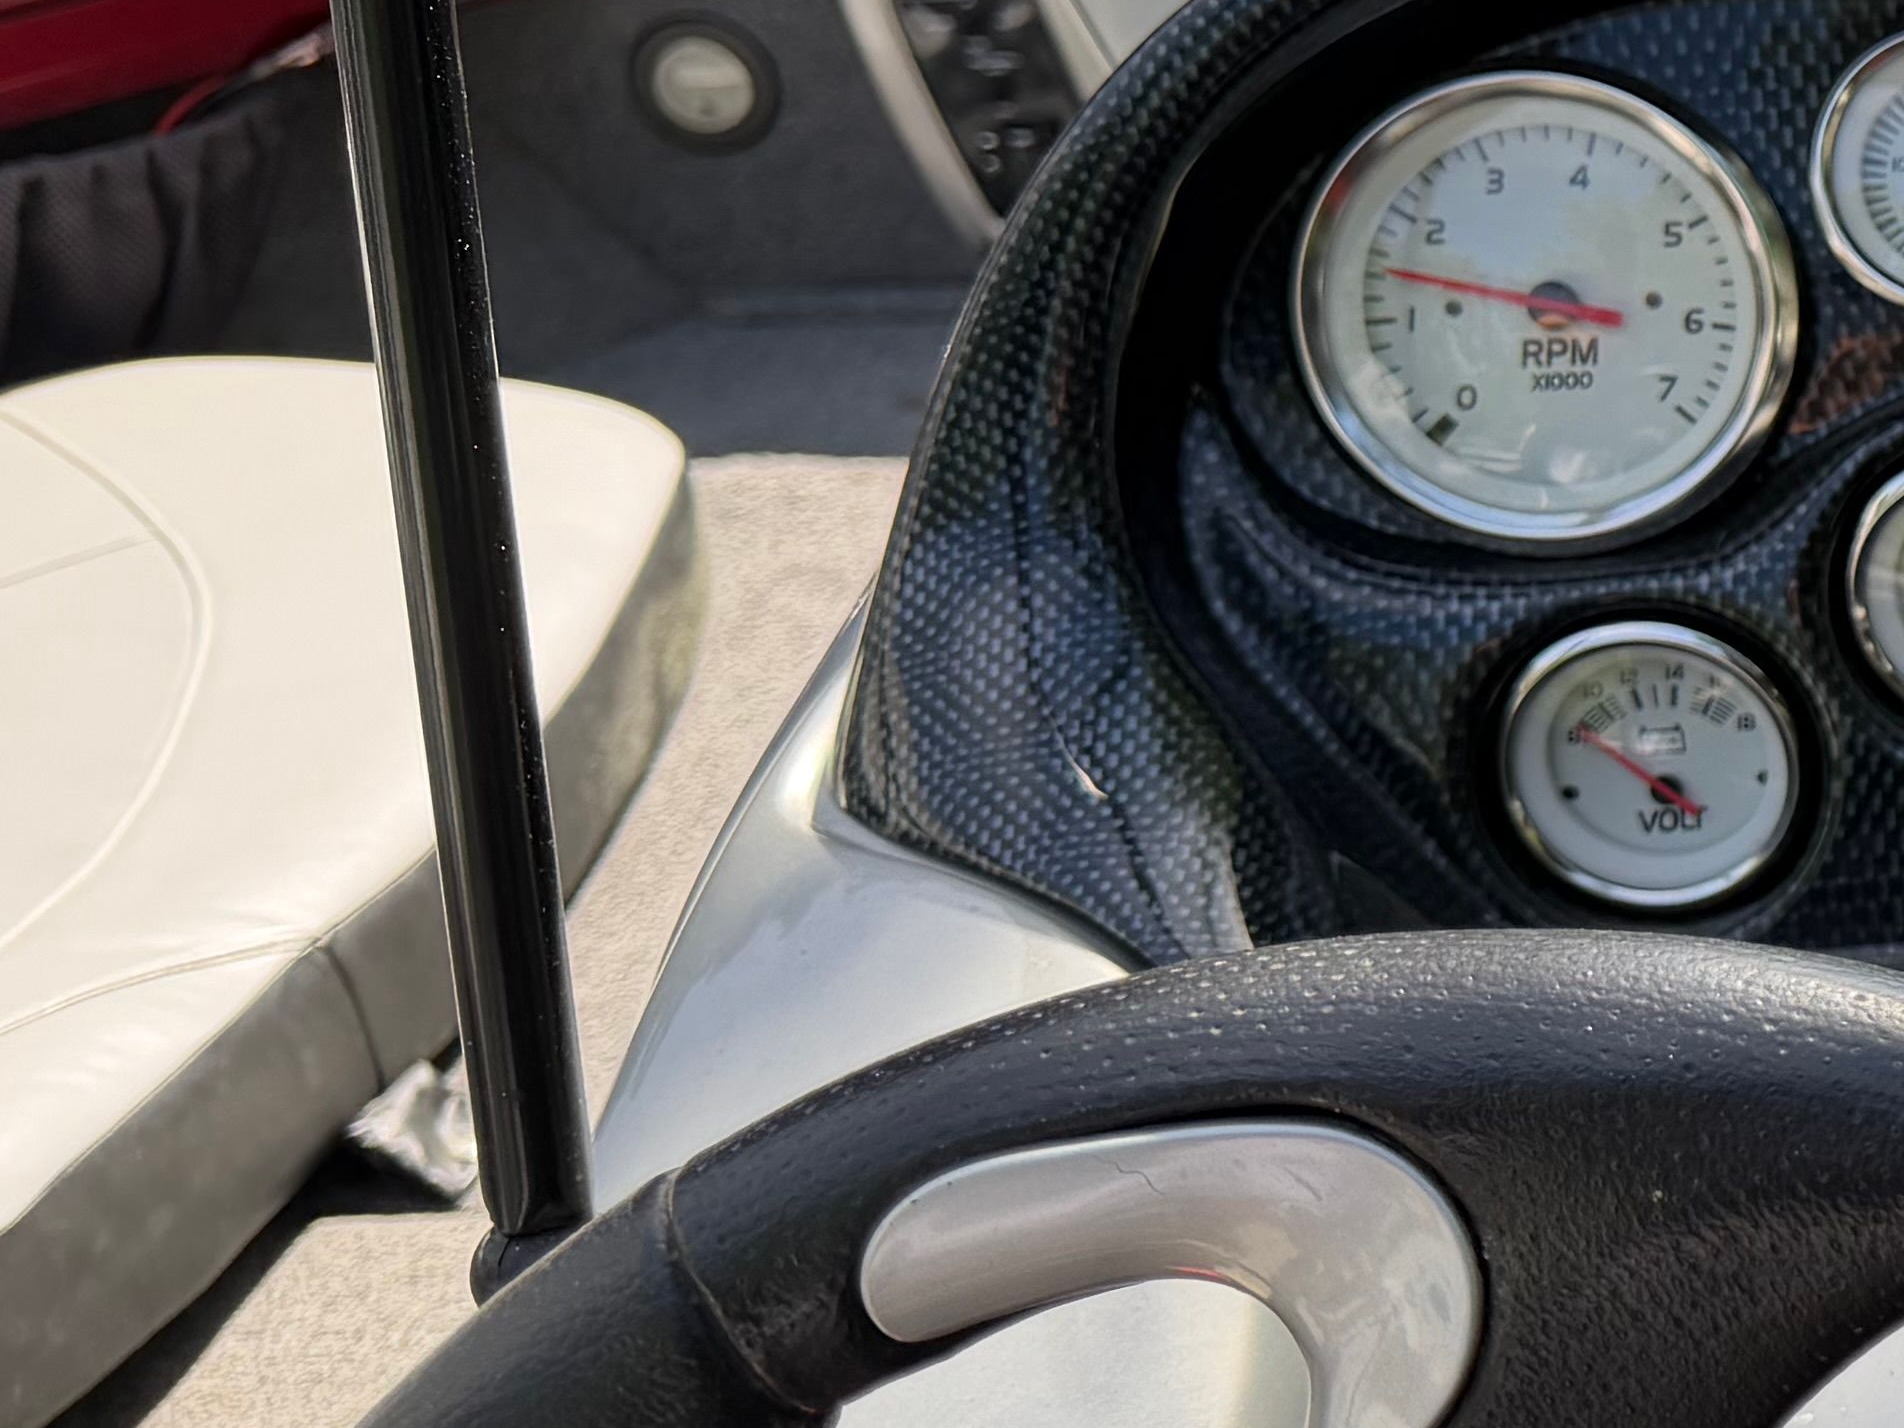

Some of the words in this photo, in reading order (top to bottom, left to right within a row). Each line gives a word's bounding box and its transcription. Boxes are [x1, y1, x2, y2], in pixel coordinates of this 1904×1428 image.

[1485, 168, 1504, 195] 3
[1568, 164, 1591, 191] 4
[1425, 218, 1446, 246] 2
[1662, 221, 1684, 249] 5
[1408, 305, 1416, 333] 1
[1684, 308, 1706, 335] 6
[1520, 338, 1600, 369] RPM
[1456, 384, 1478, 411] 0
[1658, 374, 1679, 403] 7
[1638, 805, 1708, 834] VOLT
